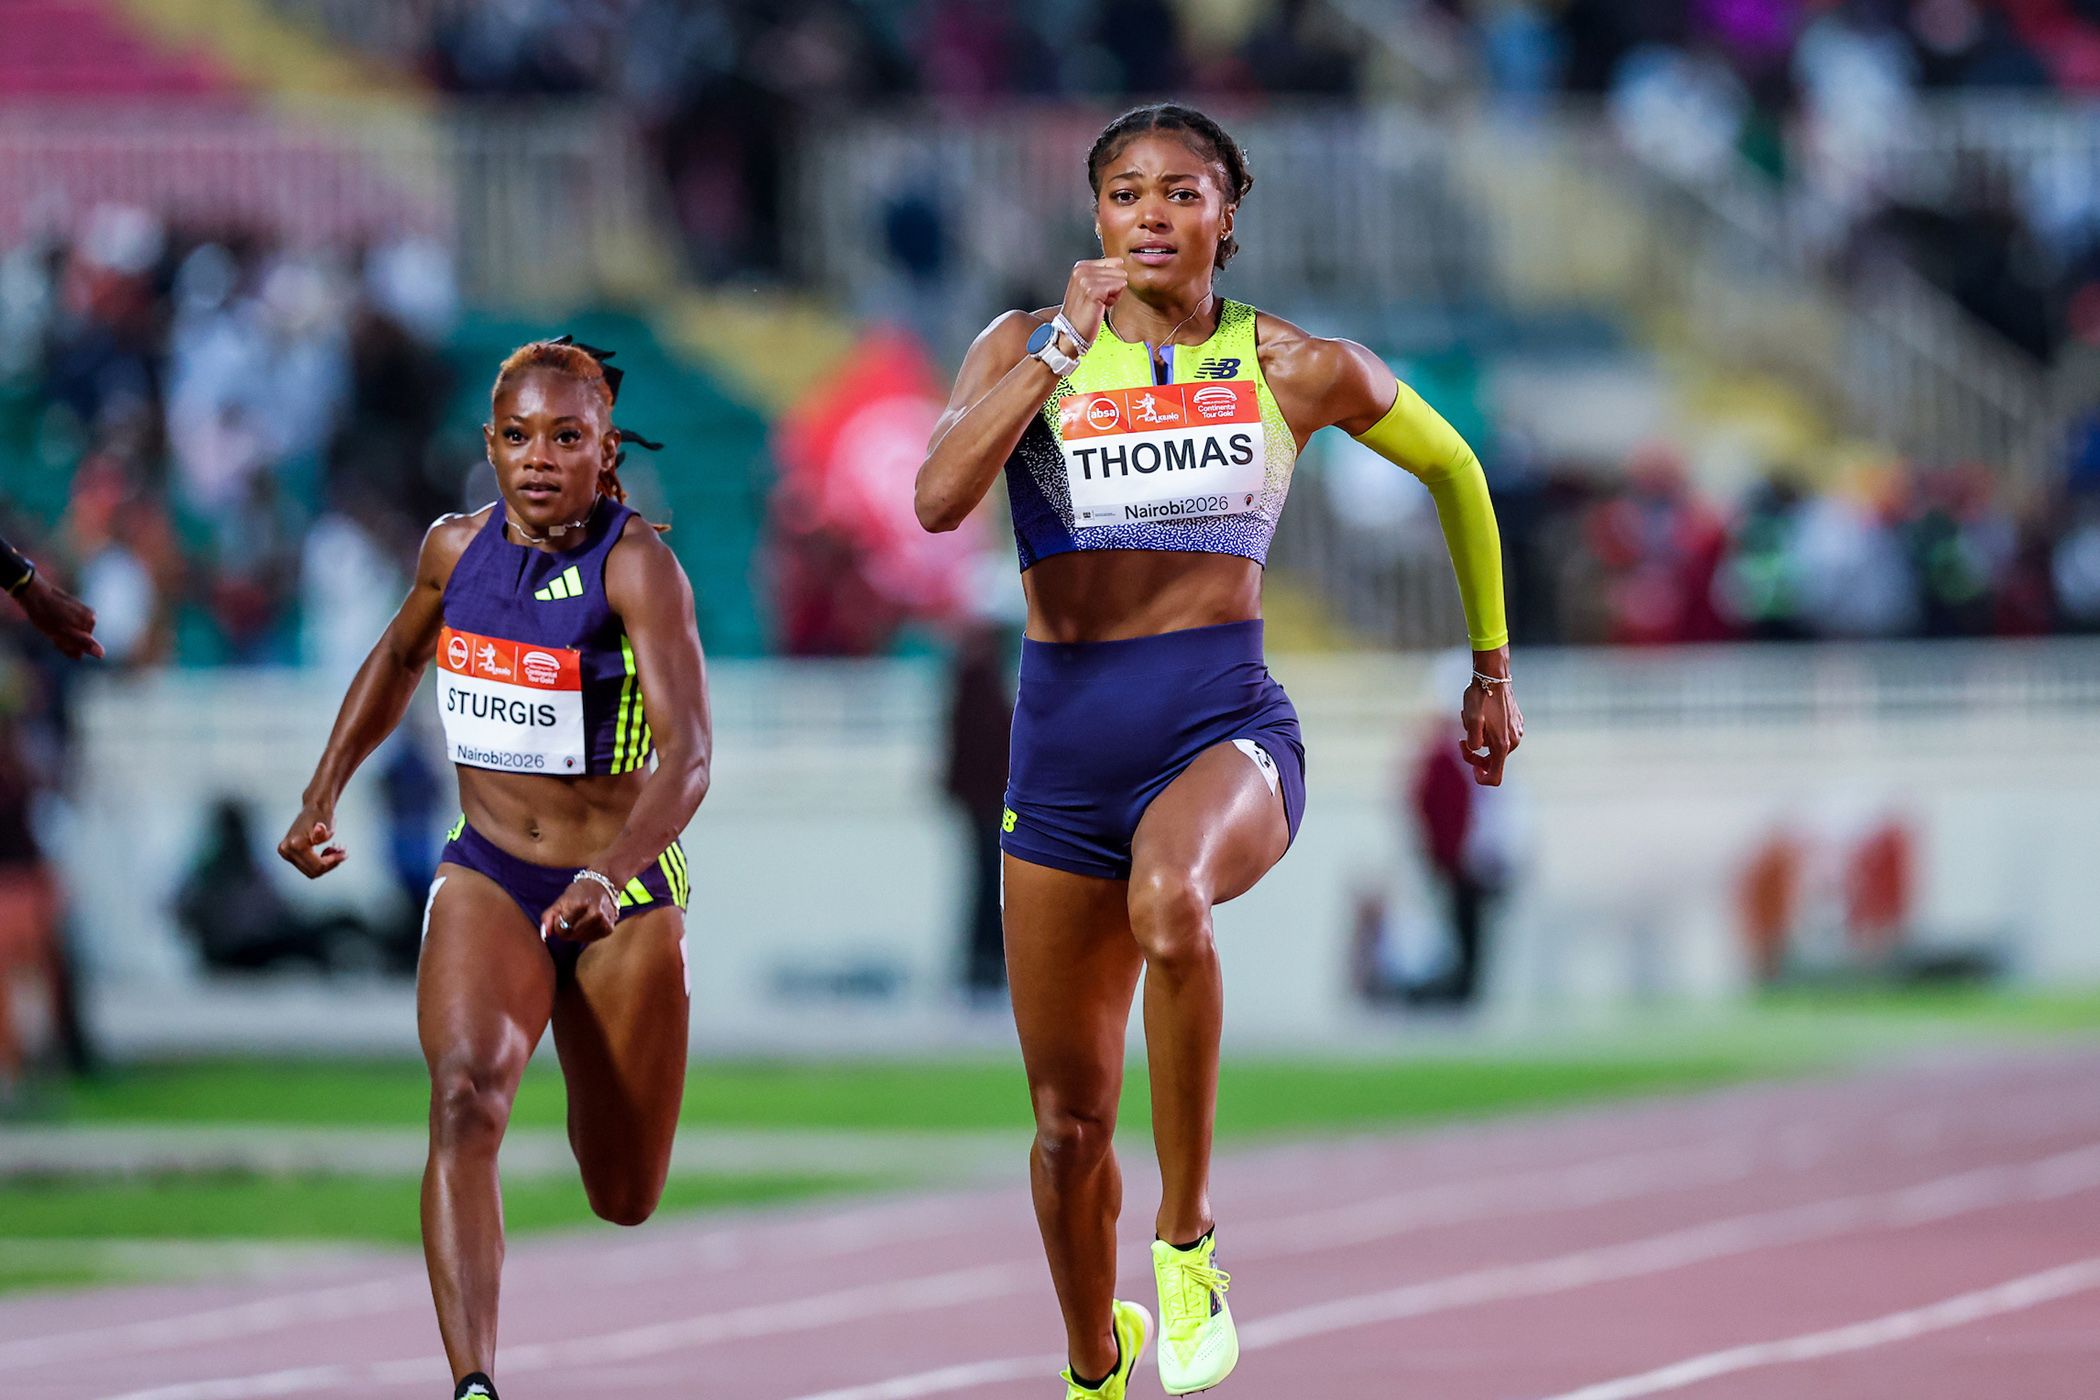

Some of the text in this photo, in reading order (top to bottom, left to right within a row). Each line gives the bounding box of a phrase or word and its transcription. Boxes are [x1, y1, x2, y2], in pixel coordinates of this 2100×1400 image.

[1091, 407, 1116, 419] absa
[1197, 403, 1236, 412] Continental
[1202, 410, 1234, 419] Tour Gold
[1073, 433, 1254, 480] THOMAS
[1124, 496, 1229, 520] Nairobi2026
[447, 687, 556, 727] STURGIS
[457, 745, 544, 768] Nairobi2026
